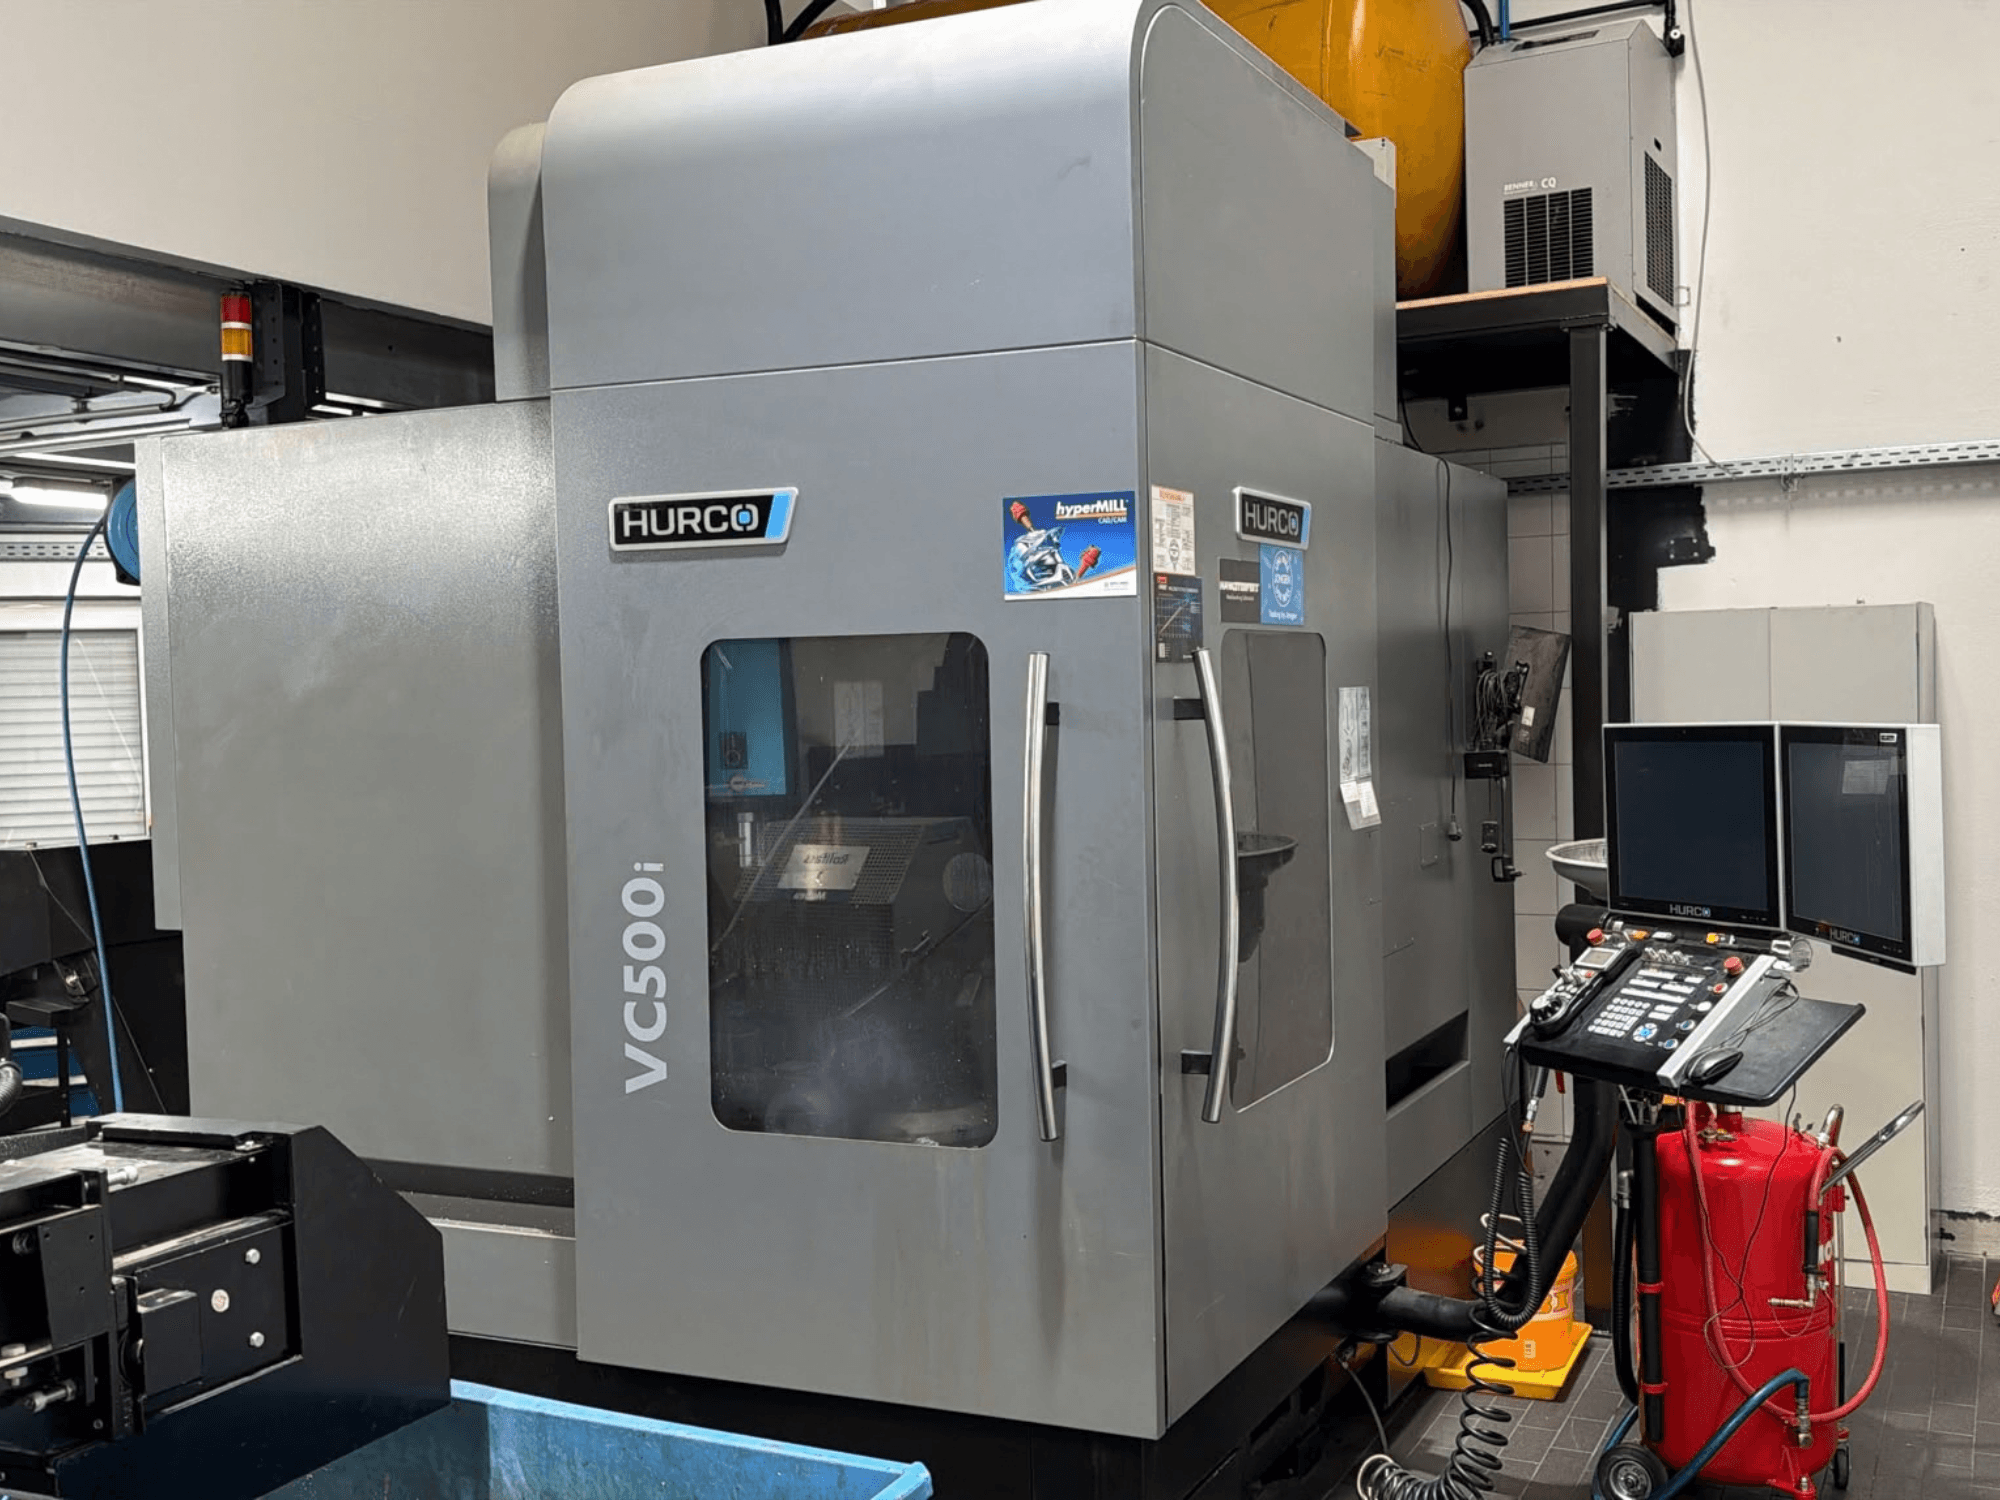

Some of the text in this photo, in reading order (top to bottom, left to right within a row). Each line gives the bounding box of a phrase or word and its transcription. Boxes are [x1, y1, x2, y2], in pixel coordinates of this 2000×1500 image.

[1541, 177, 1557, 189] CQ
[622, 503, 759, 538] HURCO
[1244, 501, 1300, 537] HURCO
[1669, 903, 1712, 918] HURCO
[1829, 927, 1861, 946] HURCO
[621, 862, 668, 1095] VC500i
